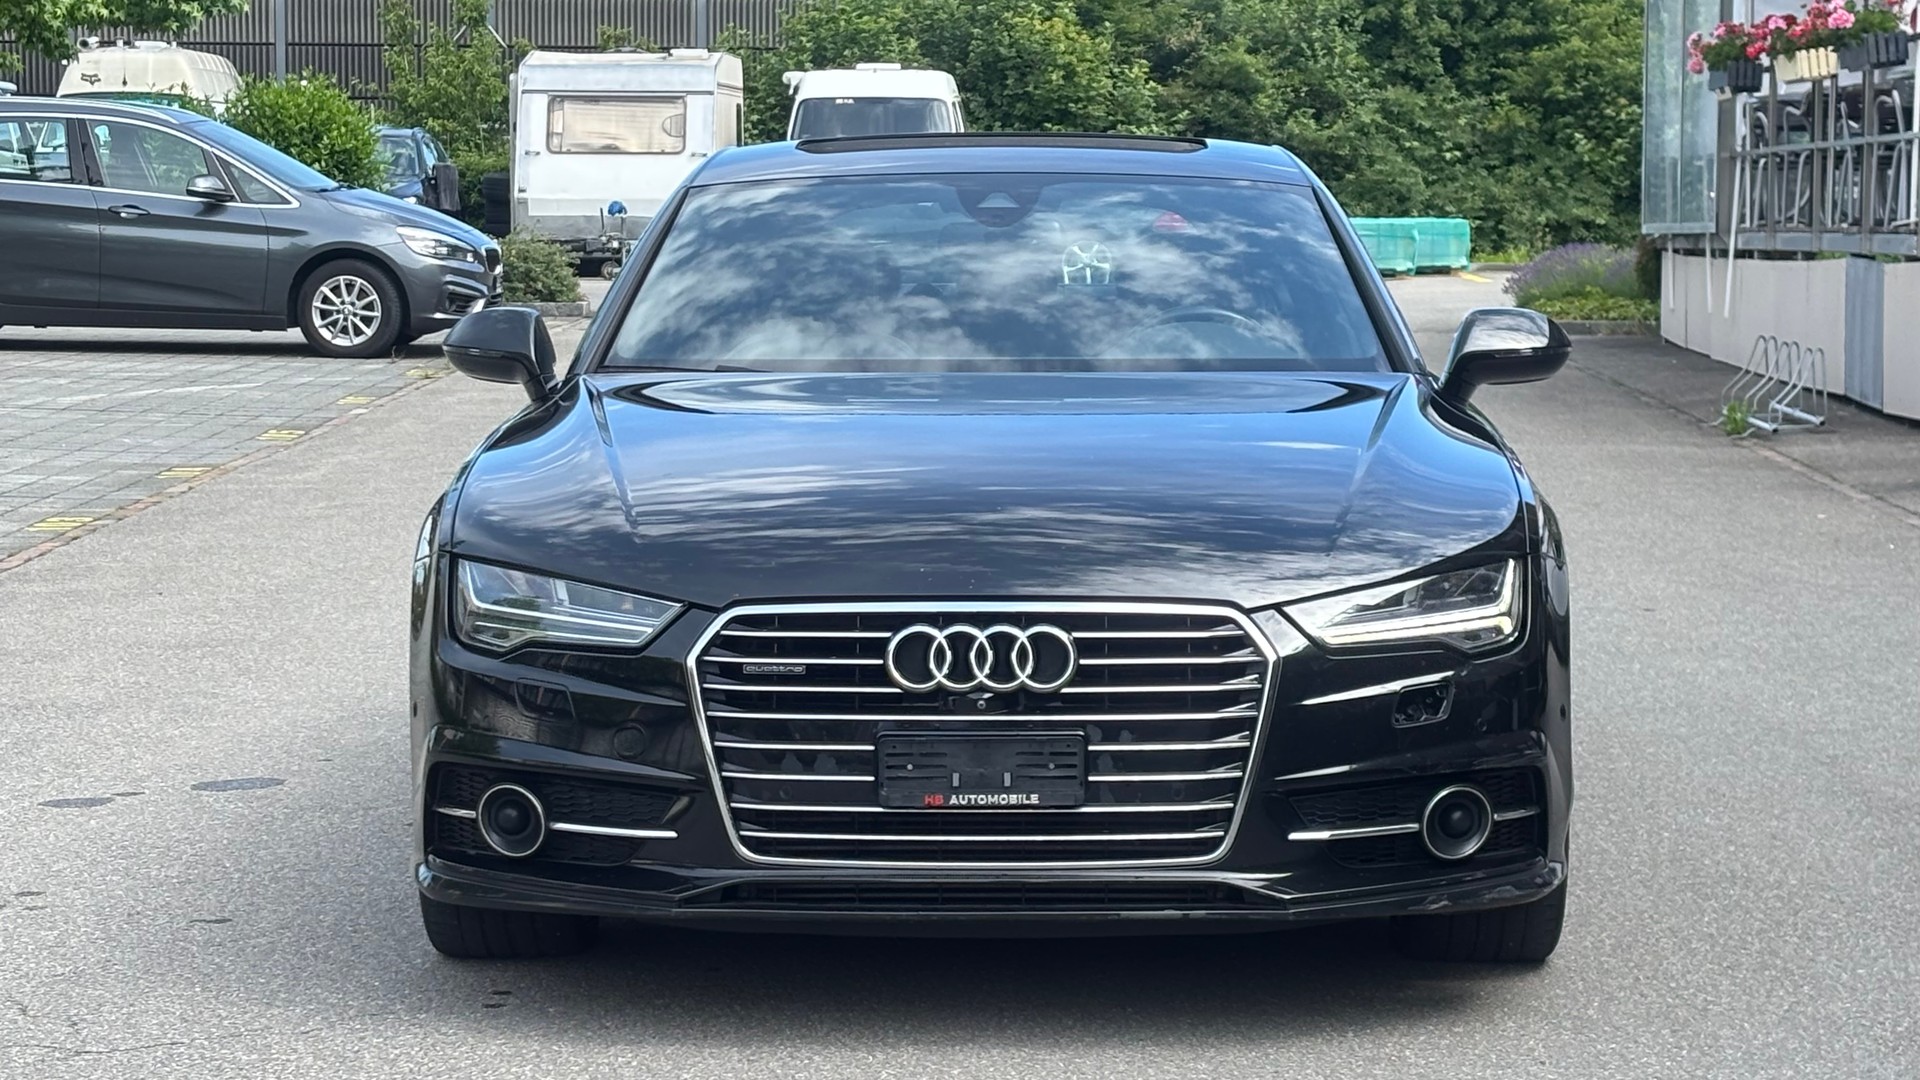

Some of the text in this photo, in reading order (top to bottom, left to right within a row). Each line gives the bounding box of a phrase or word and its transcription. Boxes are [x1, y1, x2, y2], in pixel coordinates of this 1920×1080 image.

[745, 665, 804, 673] quattro
[924, 794, 1039, 805] HB AUTOMOBILE
